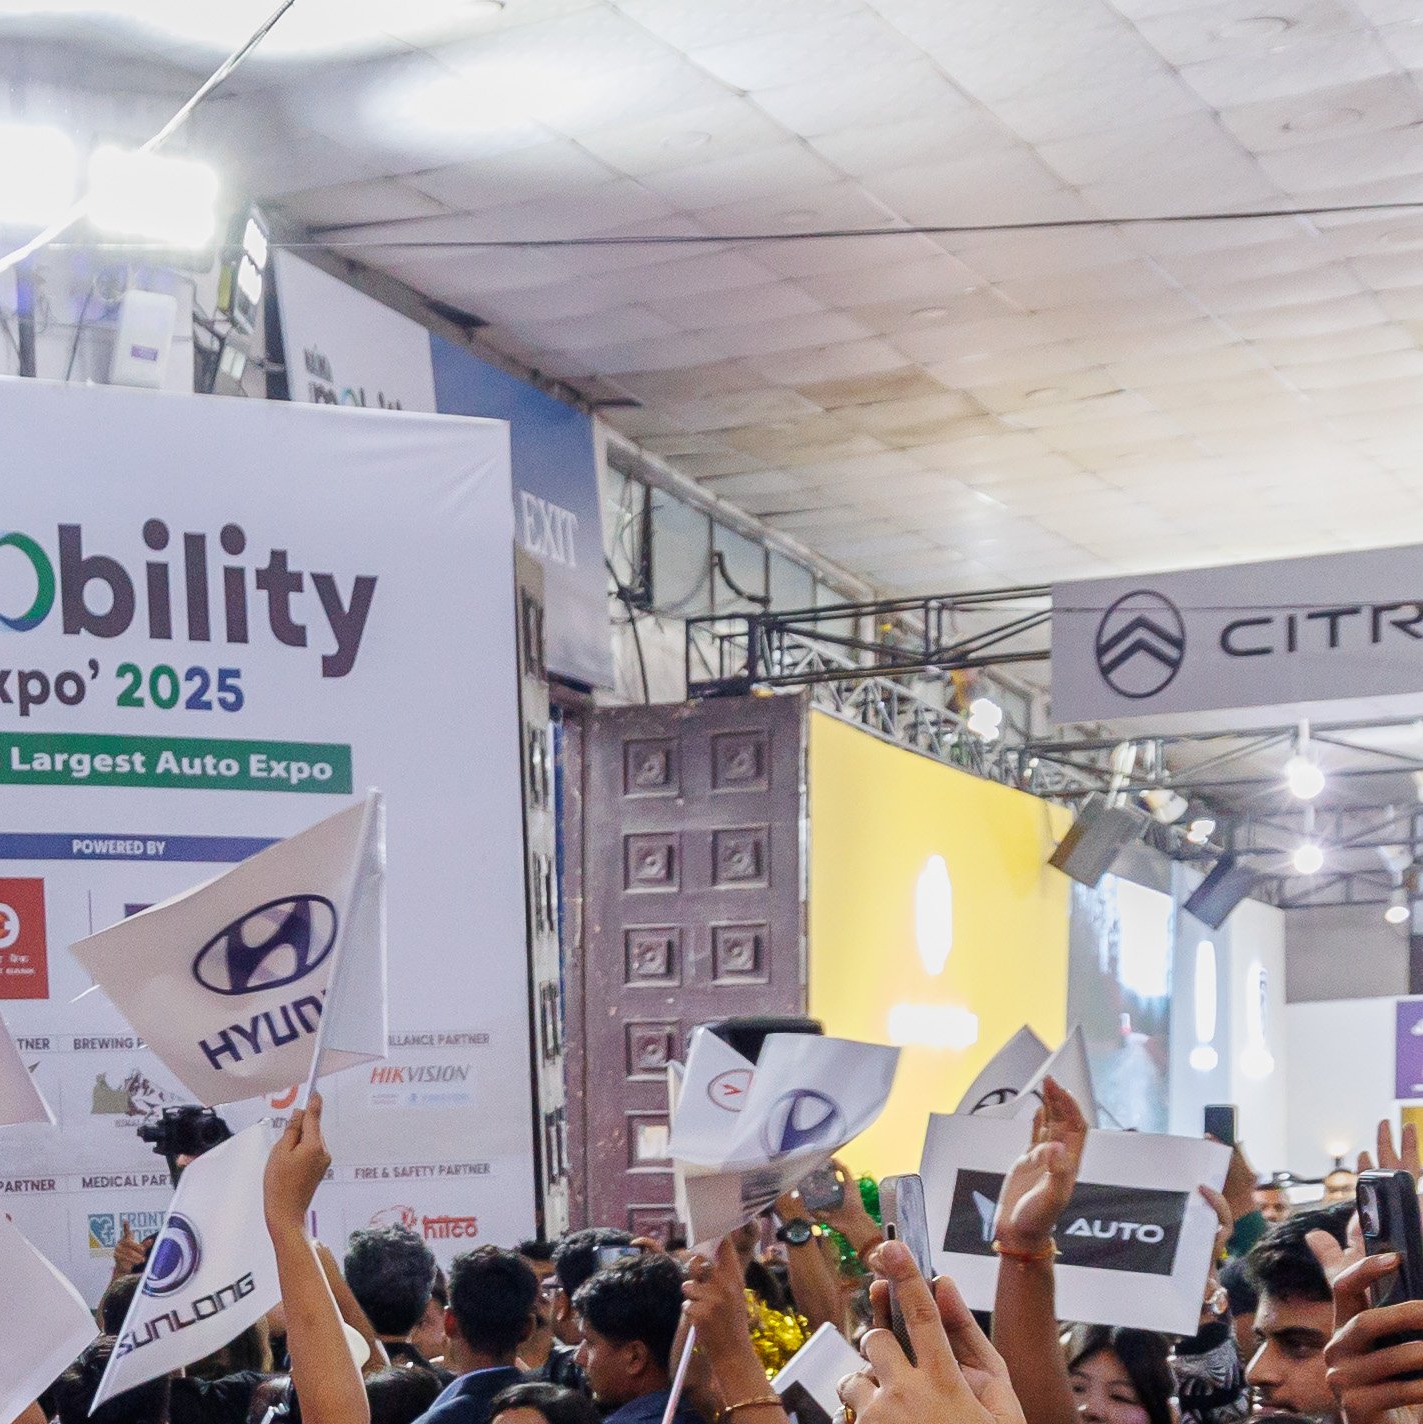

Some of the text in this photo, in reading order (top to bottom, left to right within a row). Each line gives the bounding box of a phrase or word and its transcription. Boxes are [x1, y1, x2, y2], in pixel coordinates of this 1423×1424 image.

[520, 488, 579, 568] EXIT
[1220, 601, 1423, 657] CITR
[115, 663, 245, 712] 2025
[10, 745, 147, 780] Largest
[155, 750, 240, 778] Auto
[249, 754, 334, 784] Expo
[72, 838, 166, 857] POWERED BY
[17, 1037, 50, 1051] TNER
[73, 1037, 135, 1051] BREWING
[437, 1032, 490, 1045] PARTNER
[370, 1064, 471, 1084] HIKVISION
[355, 1167, 379, 1179] FIRE
[393, 1165, 435, 1177] SAFETY
[438, 1162, 491, 1175] PARTNER
[82, 1174, 172, 1188] MEDICAL PART
[1064, 1217, 1165, 1244] AUTO
